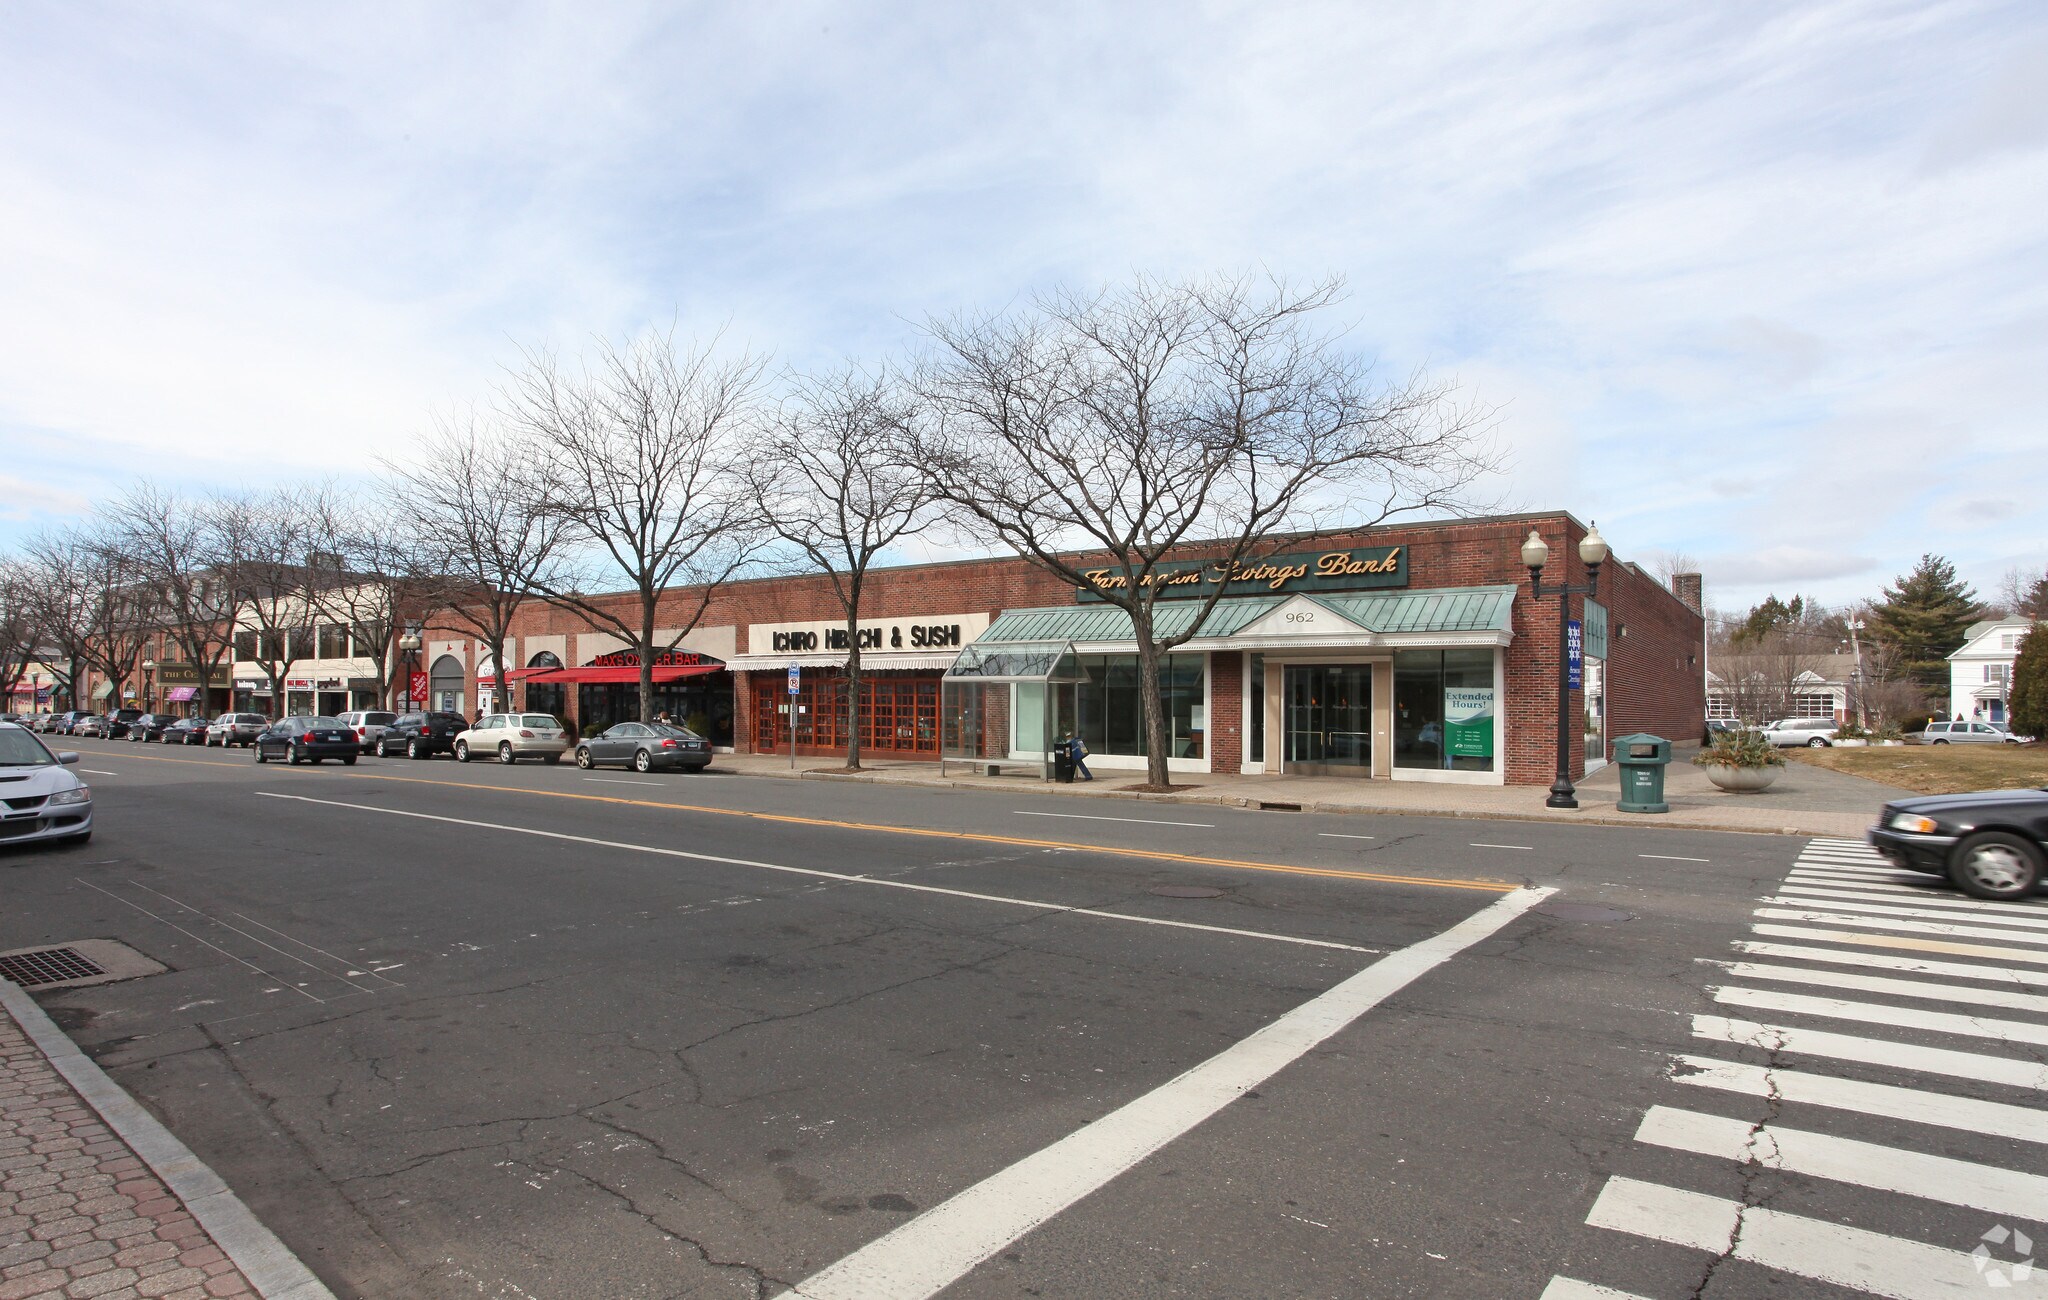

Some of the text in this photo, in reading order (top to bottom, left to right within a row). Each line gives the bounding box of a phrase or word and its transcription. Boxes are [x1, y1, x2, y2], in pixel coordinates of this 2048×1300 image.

[1313, 546, 1401, 576] Bank
[1285, 612, 1314, 624] 962
[772, 624, 960, 651] ICHIRO HIBCHI & SUSHI
[595, 655, 624, 666] MAX'S
[675, 652, 701, 666] BAR
[1446, 692, 1494, 701] Extended
[1452, 700, 1487, 709] Hours!
